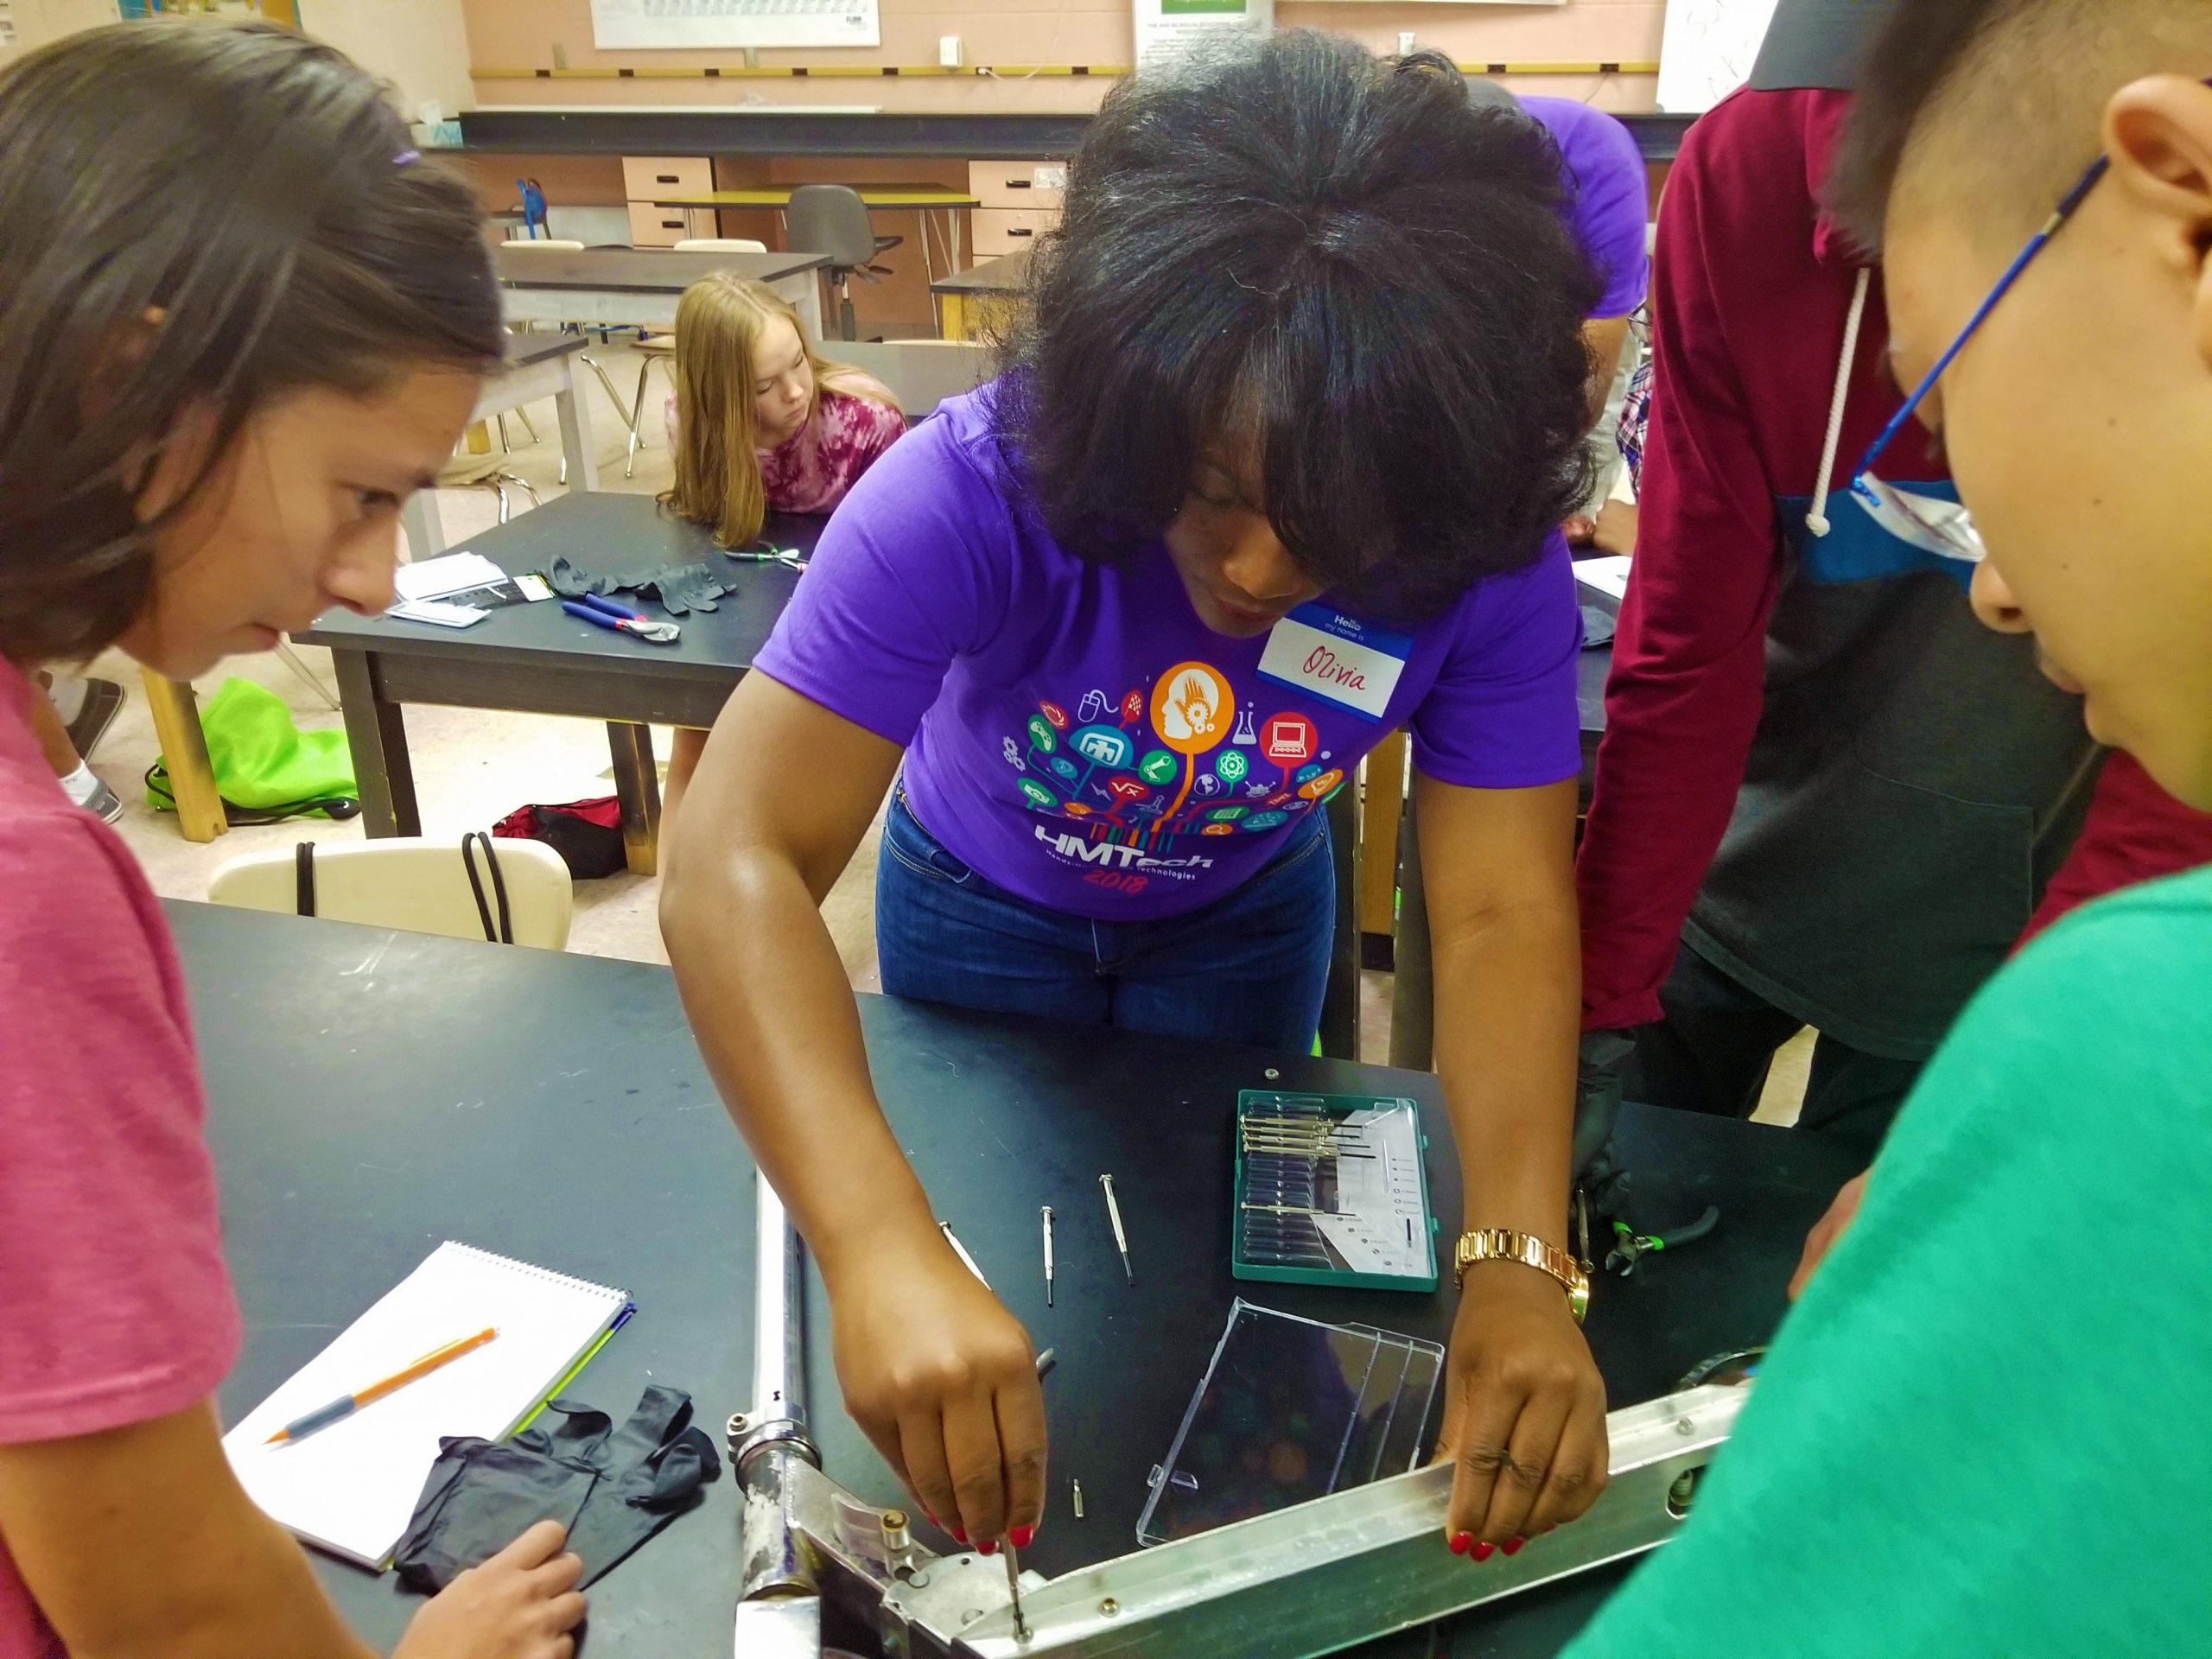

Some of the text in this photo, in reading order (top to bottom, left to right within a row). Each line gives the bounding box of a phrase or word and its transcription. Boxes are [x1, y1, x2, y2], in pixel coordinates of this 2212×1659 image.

[1325, 623, 1336, 632] my
[1337, 627, 1357, 638] name
[1334, 615, 1362, 631] Hello
[1303, 645, 1365, 690] Olivia
[1034, 824, 1214, 868] HMTech
[1084, 868, 1149, 894] 2018
